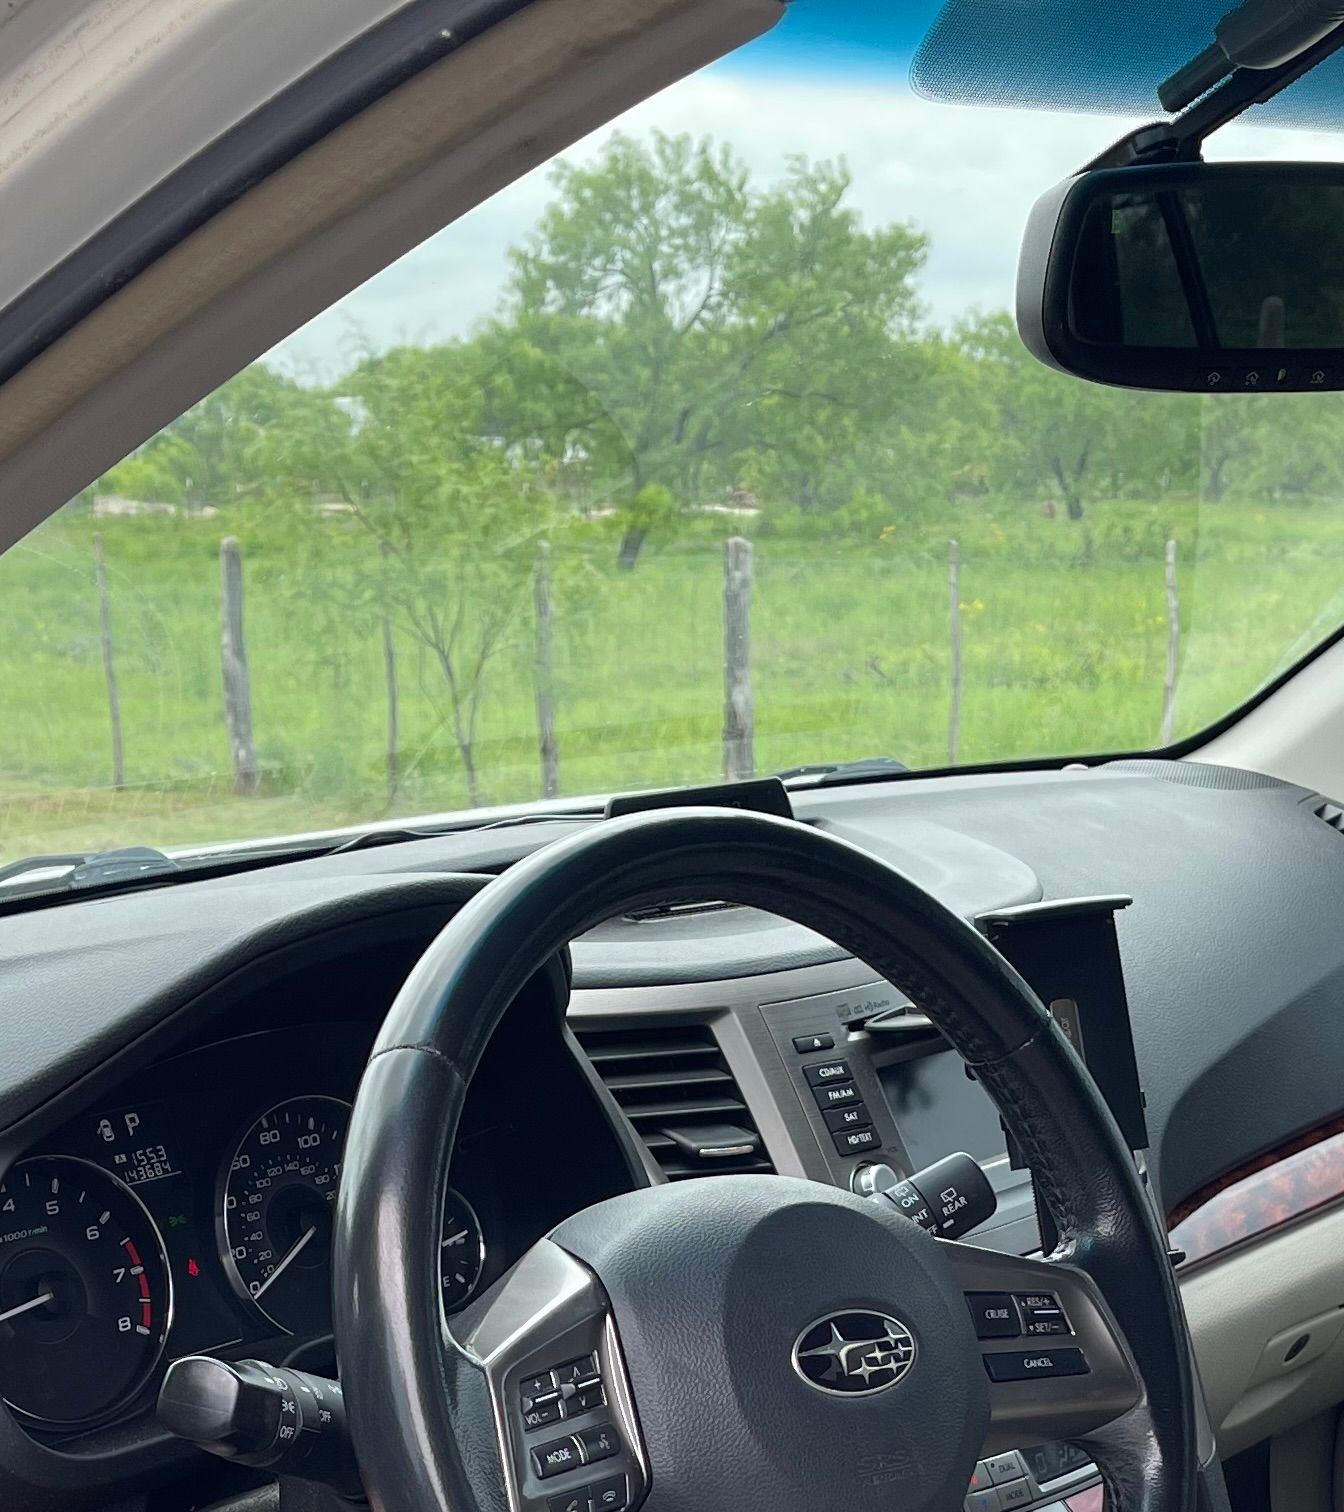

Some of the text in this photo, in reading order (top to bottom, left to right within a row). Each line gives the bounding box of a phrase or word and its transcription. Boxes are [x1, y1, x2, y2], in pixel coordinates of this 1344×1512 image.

[828, 1088, 855, 1101] FM/AM
[843, 1111, 859, 1122] SAT
[124, 1112, 140, 1137] P
[259, 1130, 320, 1149] 80 100
[124, 1161, 172, 1183] 143684
[267, 1166, 283, 1178] 120
[284, 1161, 300, 1172] 140
[300, 1164, 315, 1176] 160
[255, 1178, 271, 1189] 100
[314, 1174, 330, 1185] 180
[2, 1198, 15, 1212] 4
[248, 1193, 263, 1204] 80
[901, 1193, 919, 1208] ON
[45, 1200, 59, 1215] 5
[942, 1196, 968, 1217] REAR
[246, 1211, 261, 1222] 60
[86, 1225, 100, 1240] 6
[927, 1223, 938, 1235] FF
[250, 1231, 263, 1242] 40
[258, 1250, 272, 1261] 20
[112, 1267, 126, 1283] 7
[442, 1275, 451, 1288] E
[985, 1308, 1010, 1320] CRUISE
[118, 1316, 131, 1331] 8
[1023, 1357, 1053, 1369] CANCEL
[525, 1413, 542, 1425] VOL
[280, 1425, 295, 1439] OFF
[546, 1447, 572, 1464] MODE
[998, 1461, 1016, 1474] DUAL
[1006, 1488, 1024, 1501] MODE
